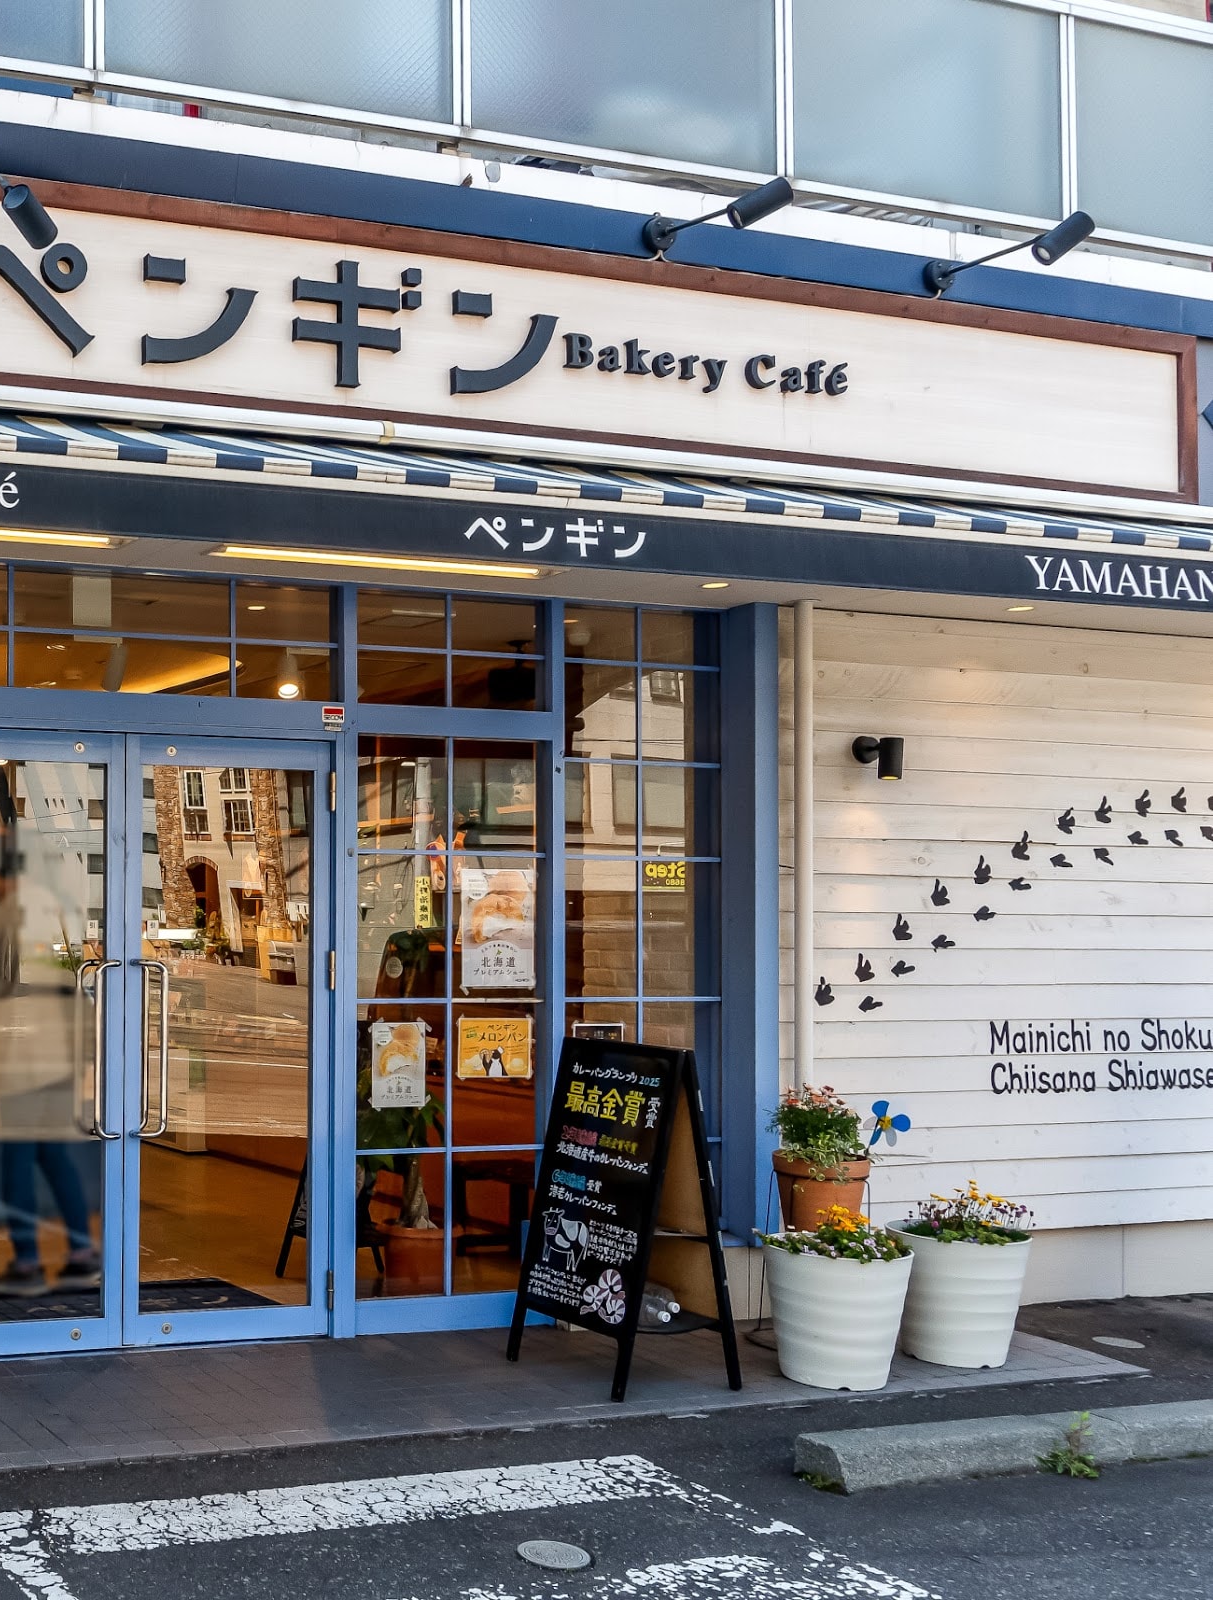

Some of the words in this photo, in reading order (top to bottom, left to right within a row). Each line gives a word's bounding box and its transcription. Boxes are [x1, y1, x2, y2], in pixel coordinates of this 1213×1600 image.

[562, 332, 727, 394] Bakery
[744, 353, 849, 397] Café
[464, 516, 647, 558] ペンギン
[1024, 554, 1213, 602] YAMAHAN
[481, 956, 516, 968] 北海道
[478, 1032, 526, 1042] メロンパン
[989, 1019, 1092, 1055] Mainichi
[1103, 1028, 1131, 1052] no
[1140, 1018, 1213, 1052] Shoku
[387, 1085, 412, 1094] 北海道
[572, 1062, 638, 1083] カレーパングランプリ
[638, 1075, 661, 1087] 2025
[990, 1060, 1096, 1095] Chiisana
[1107, 1058, 1213, 1092] Shiawase
[564, 1081, 646, 1127] 最高金賞
[645, 1097, 661, 1129] 受賞
